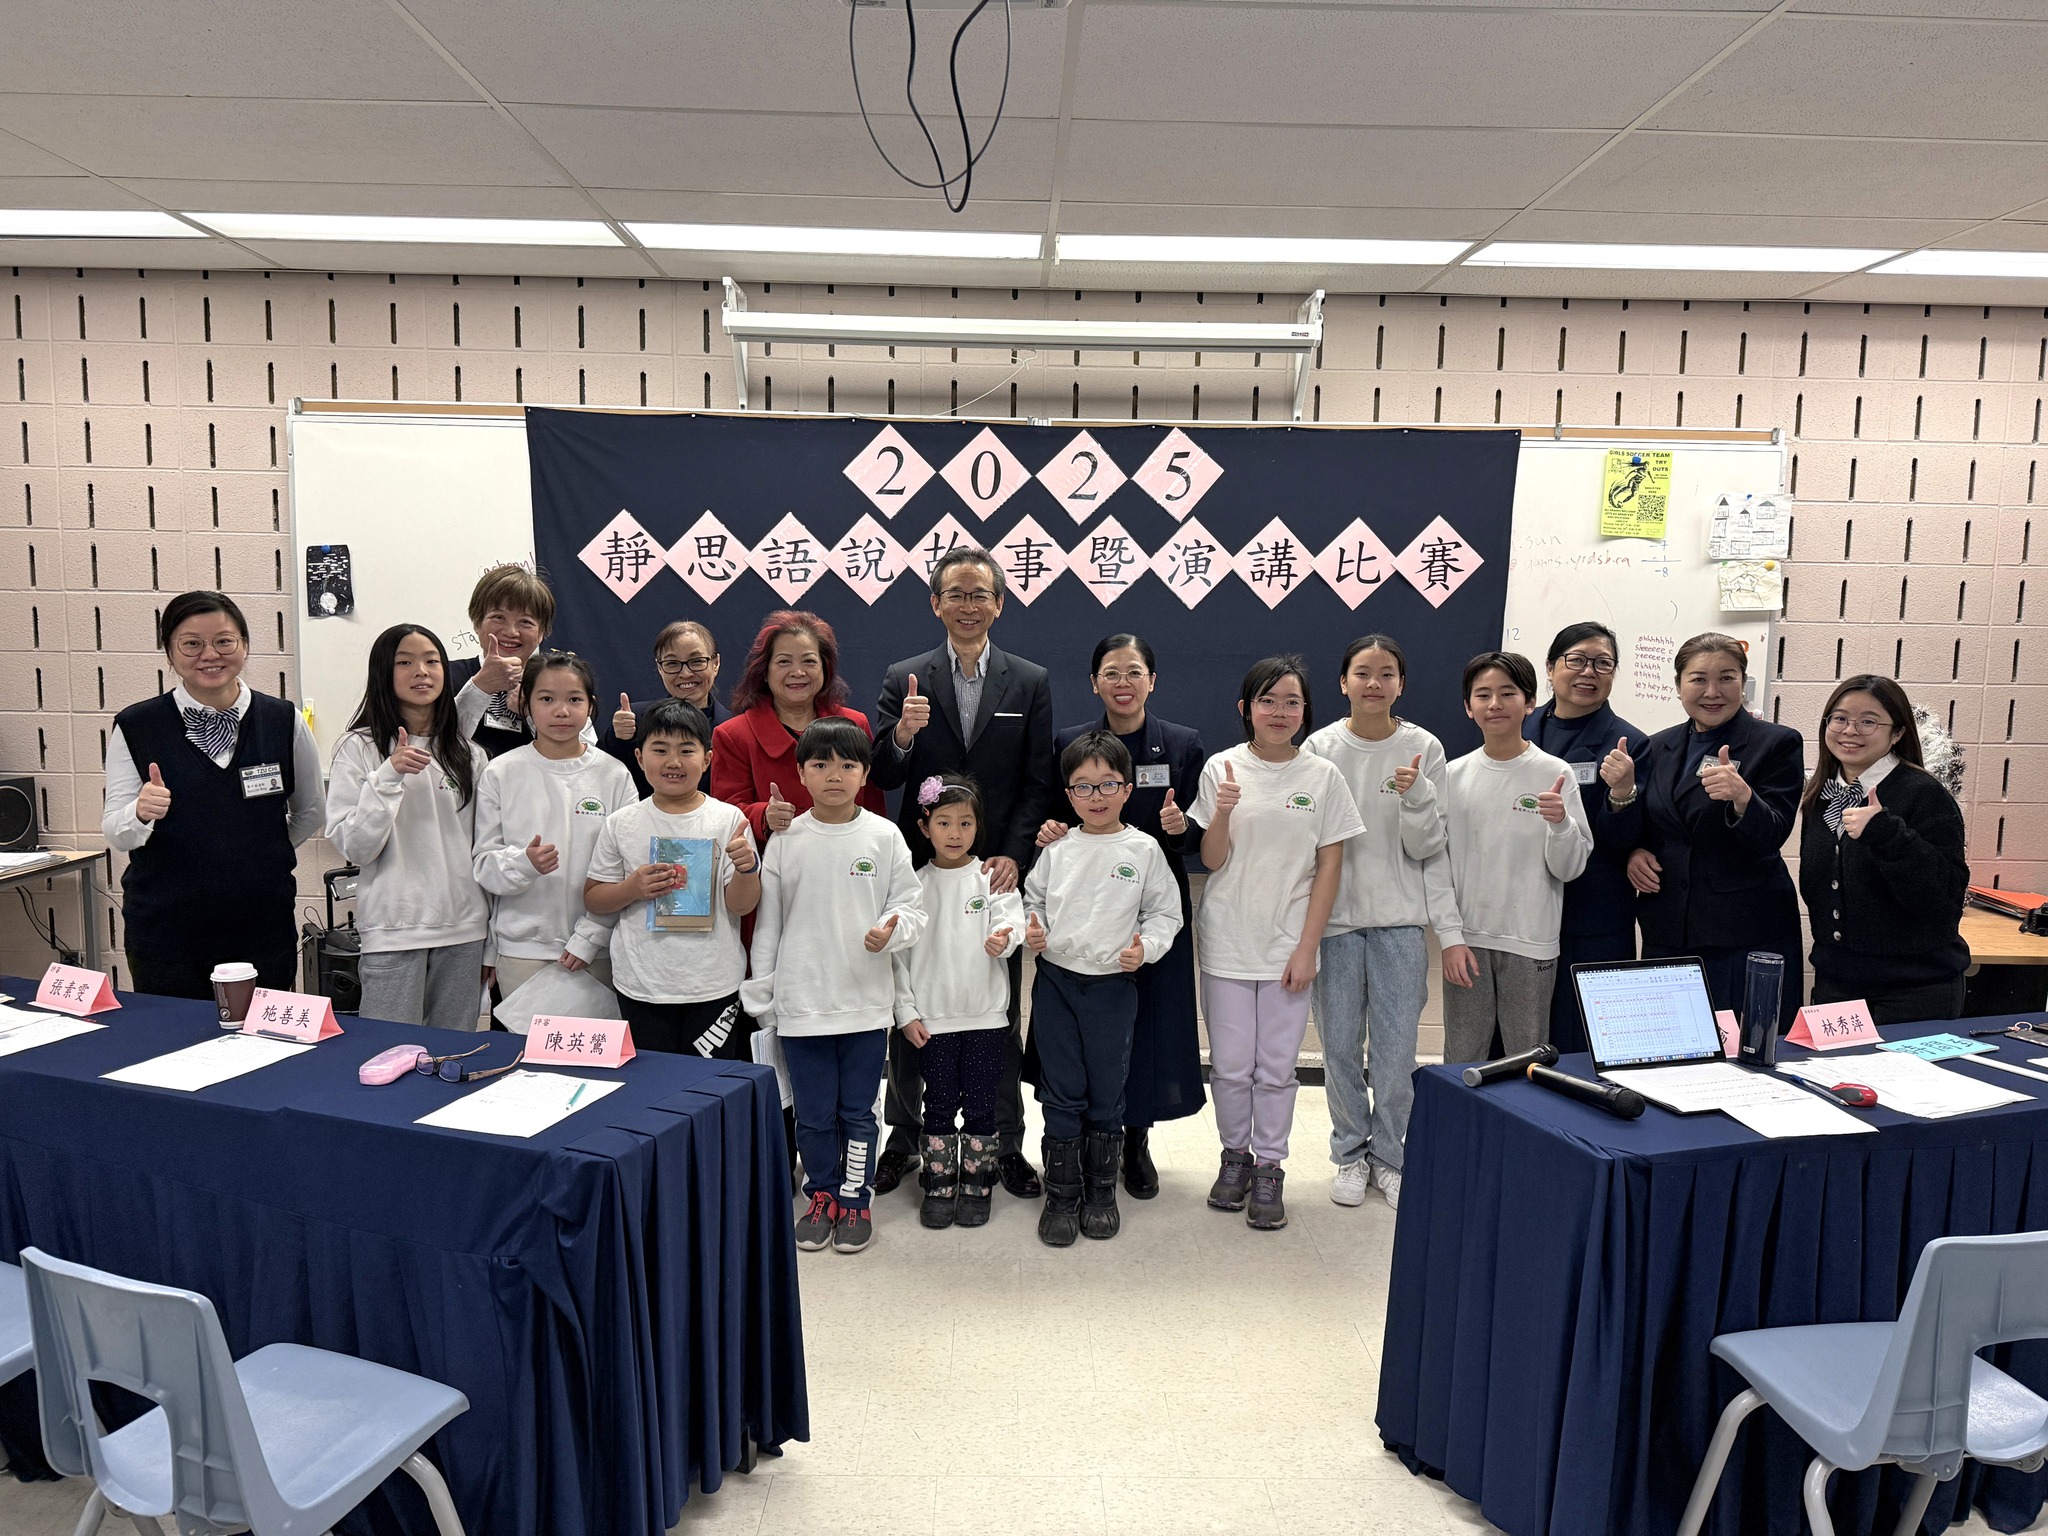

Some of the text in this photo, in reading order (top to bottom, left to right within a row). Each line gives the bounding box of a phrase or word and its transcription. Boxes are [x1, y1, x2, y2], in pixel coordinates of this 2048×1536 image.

[875, 446, 1192, 501] 2025
[260, 1004, 310, 1029] 施善美
[692, 1000, 741, 1059] PUM
[1821, 1013, 1864, 1037] 林秀萍
